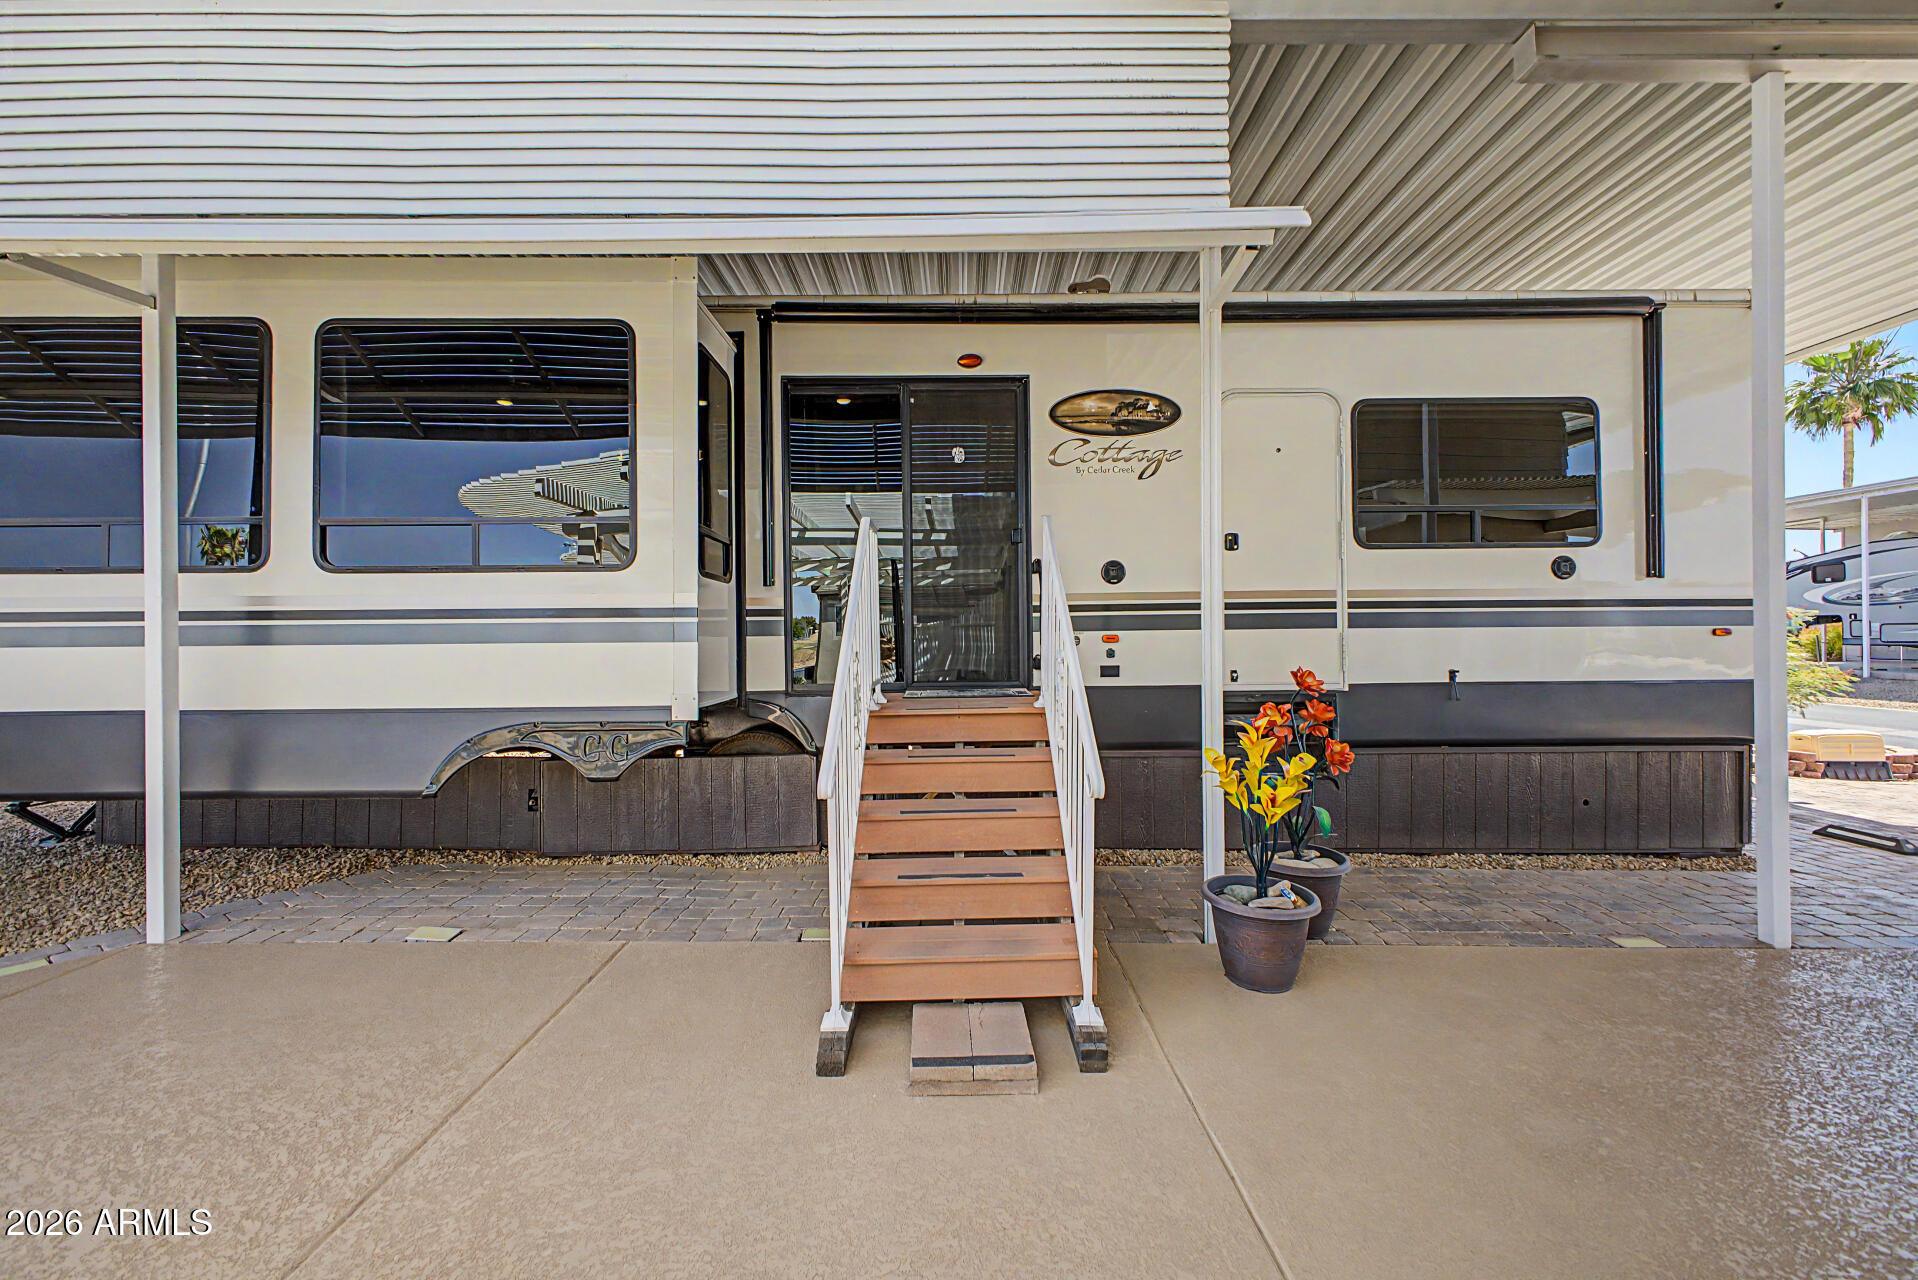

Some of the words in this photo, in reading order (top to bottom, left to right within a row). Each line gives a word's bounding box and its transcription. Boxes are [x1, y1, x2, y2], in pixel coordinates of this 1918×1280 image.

[1048, 438, 1184, 480] Cottage
[1076, 466, 1086, 476] By
[1087, 466, 1111, 474] Cedar
[1112, 466, 1136, 474] Creek
